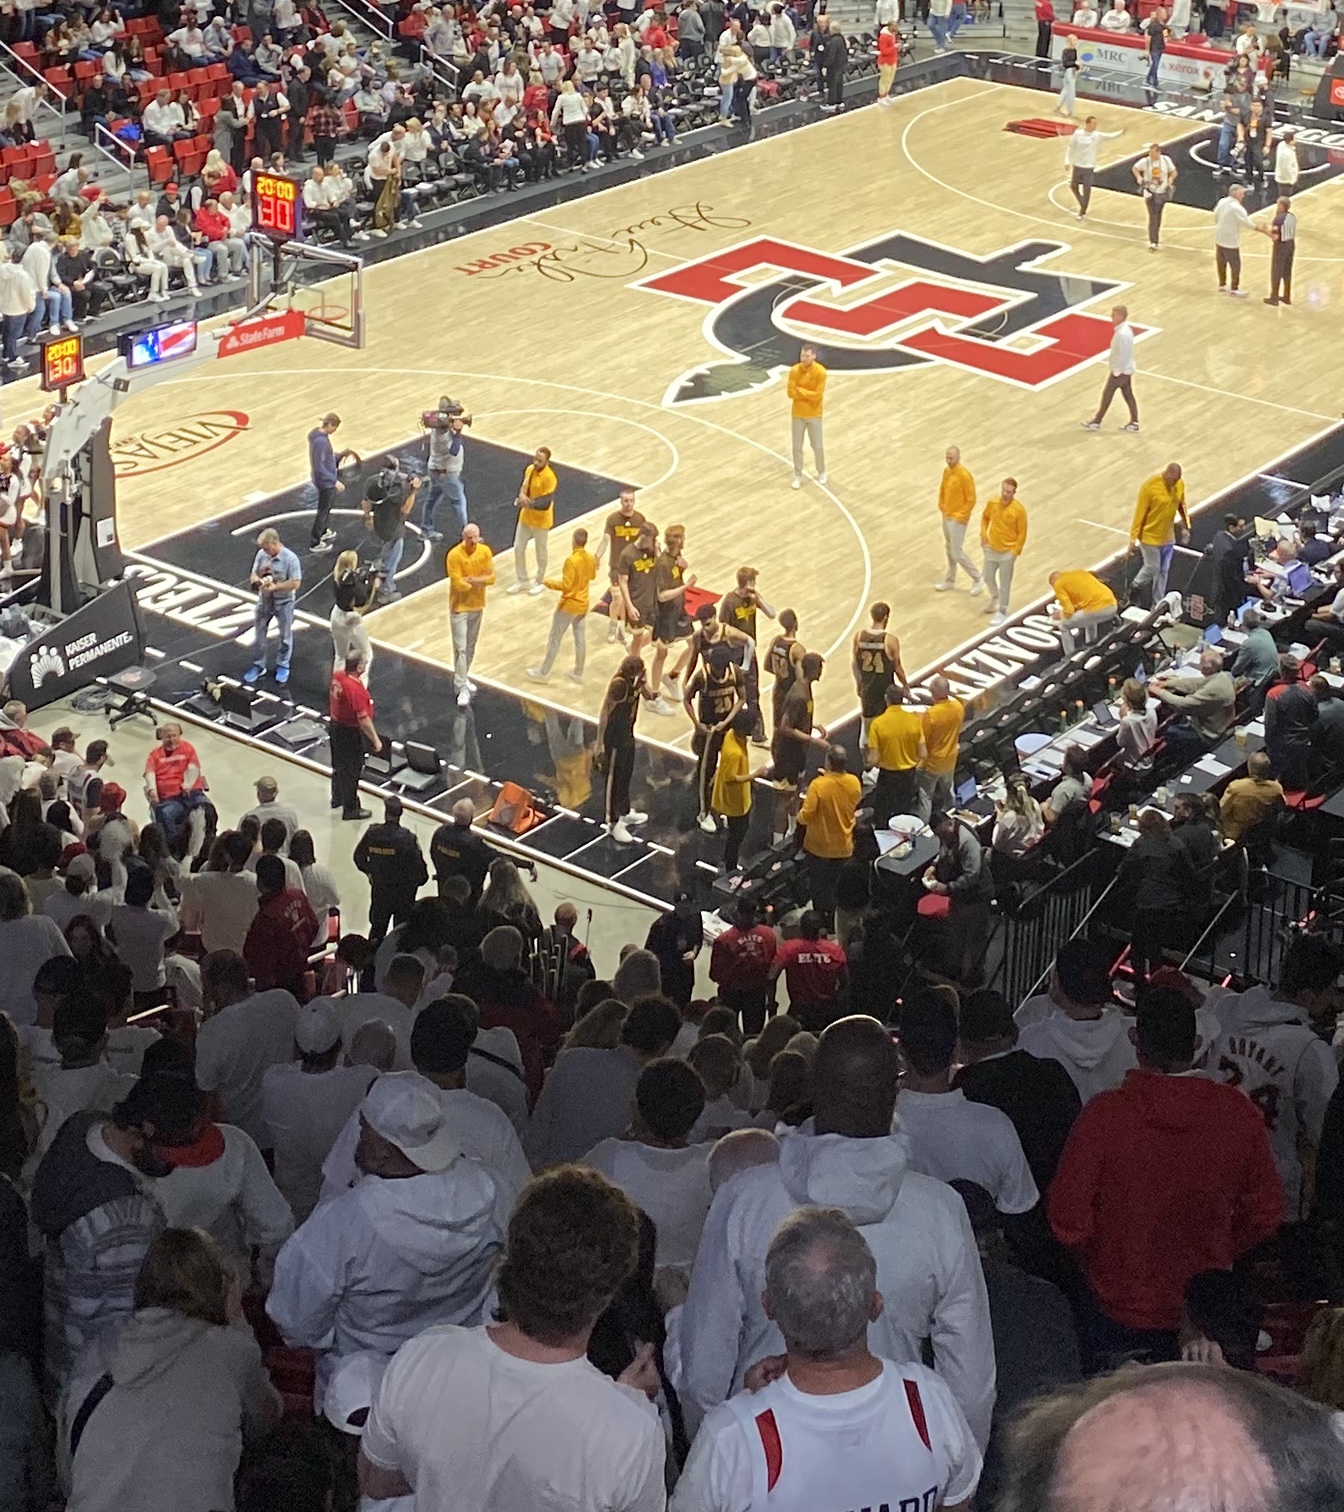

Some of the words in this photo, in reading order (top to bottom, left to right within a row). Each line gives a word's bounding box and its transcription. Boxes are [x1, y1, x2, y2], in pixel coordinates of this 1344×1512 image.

[1096, 48, 1128, 64] MRC
[1167, 62, 1199, 77] xerox
[1143, 101, 1225, 122] SAN
[256, 176, 294, 201] 20:00
[260, 195, 290, 231] 30
[453, 242, 552, 276] COURT
[47, 338, 77, 362] 20:00
[53, 357, 73, 379] 30
[65, 632, 97, 657] KAISER
[861, 650, 885, 674] 24
[737, 934, 764, 946] ELITE
[798, 952, 832, 965] ELITE
[1228, 1035, 1285, 1078] BRYANT
